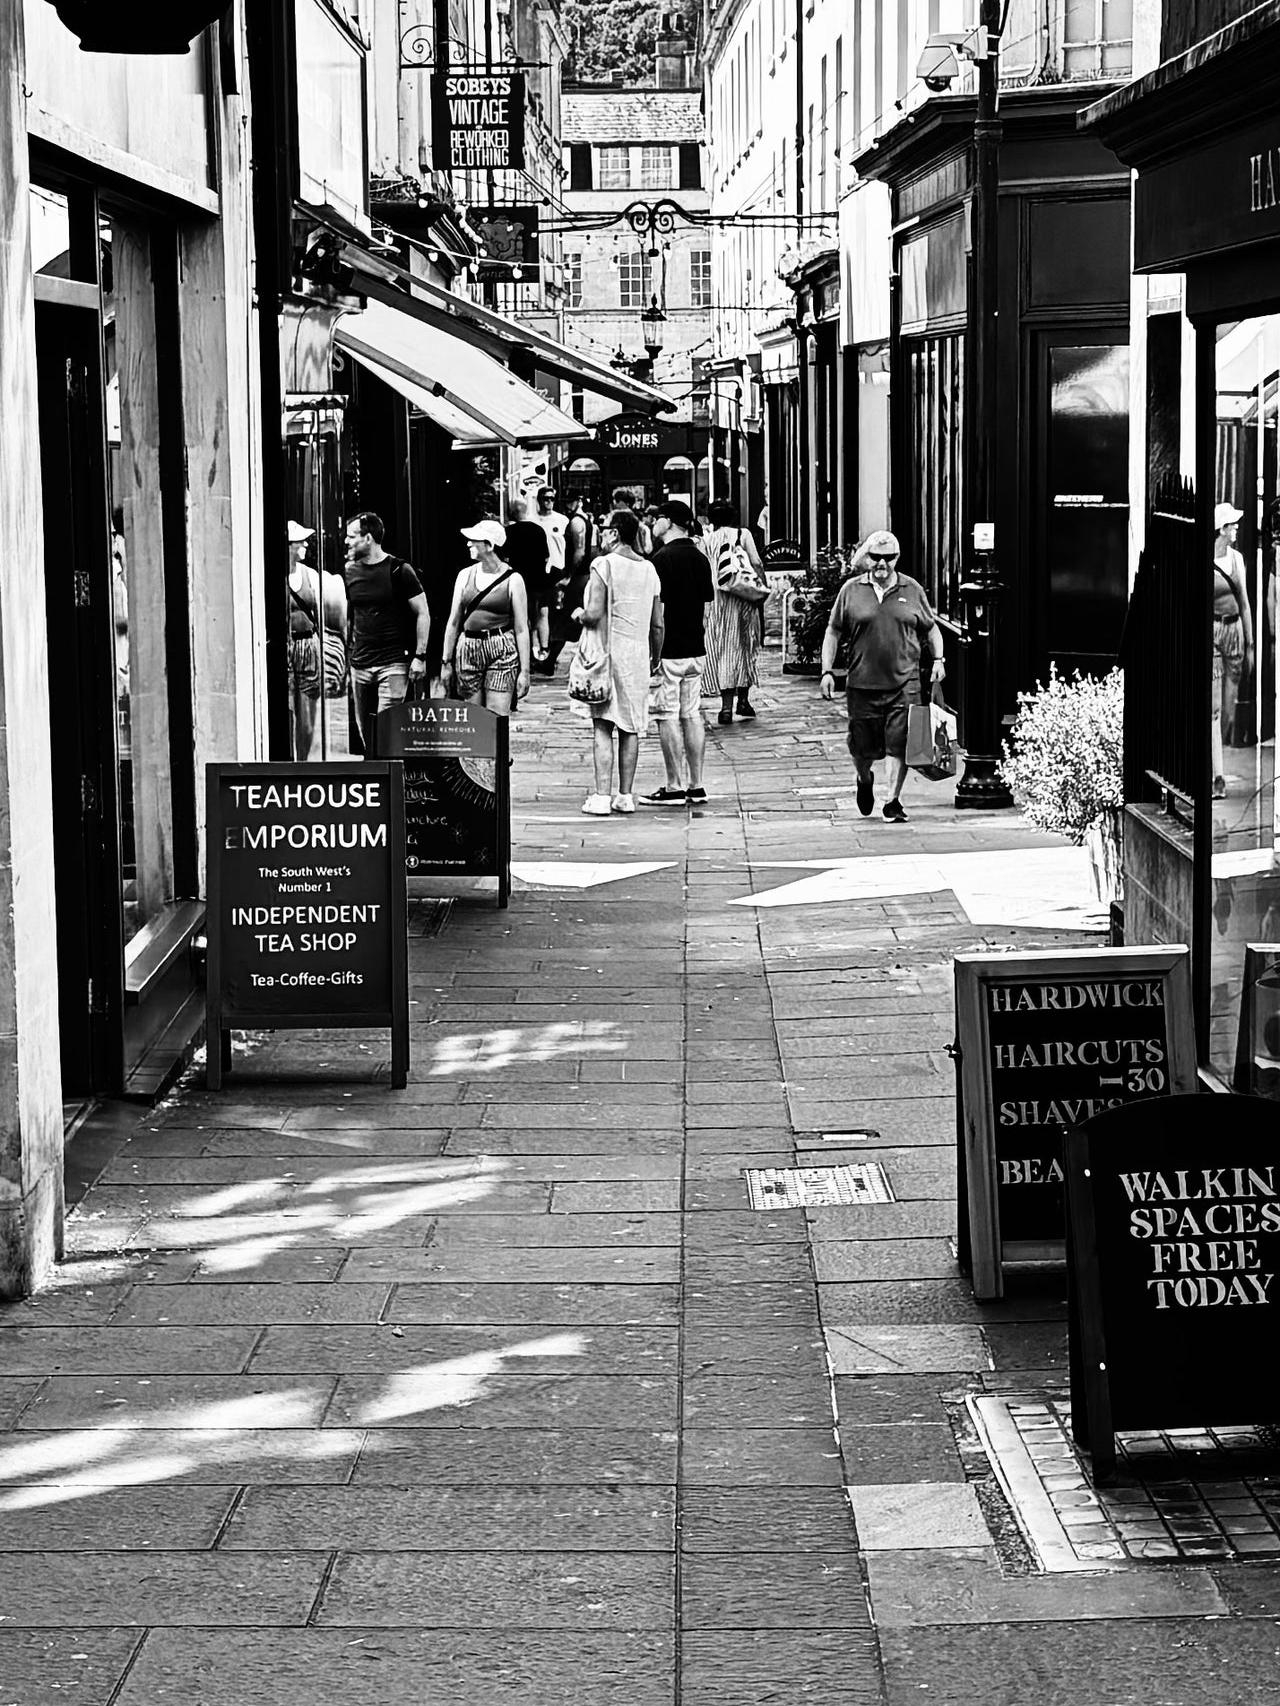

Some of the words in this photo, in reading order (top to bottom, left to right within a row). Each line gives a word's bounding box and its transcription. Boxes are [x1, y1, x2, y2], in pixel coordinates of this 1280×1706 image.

[445, 77, 511, 96] SOBEYS
[448, 98, 509, 125] VINTAGE
[450, 129, 509, 149] REWORKED
[451, 147, 509, 167] CLOTHING
[608, 430, 659, 448] JONES
[409, 706, 469, 723] BATH
[229, 782, 381, 809] TEAHOUSE
[224, 823, 388, 850] EMPORIUM
[258, 866, 279, 878] The
[281, 866, 312, 878] South
[314, 865, 352, 877] West's
[277, 881, 323, 894] Number
[325, 881, 332, 893] 1
[231, 904, 381, 926] INDEPENDENT
[254, 934, 295, 953] TEA
[299, 932, 358, 952] SHOP
[250, 970, 364, 987] Tea-Coffee-Gifts
[990, 981, 1165, 1013] HARDWICK
[994, 1038, 1165, 1069] HAIRCUTS
[1118, 1166, 1278, 1204] WALKIN
[1150, 1239, 1262, 1274] FREE
[1146, 1273, 1276, 1310] TODAY
